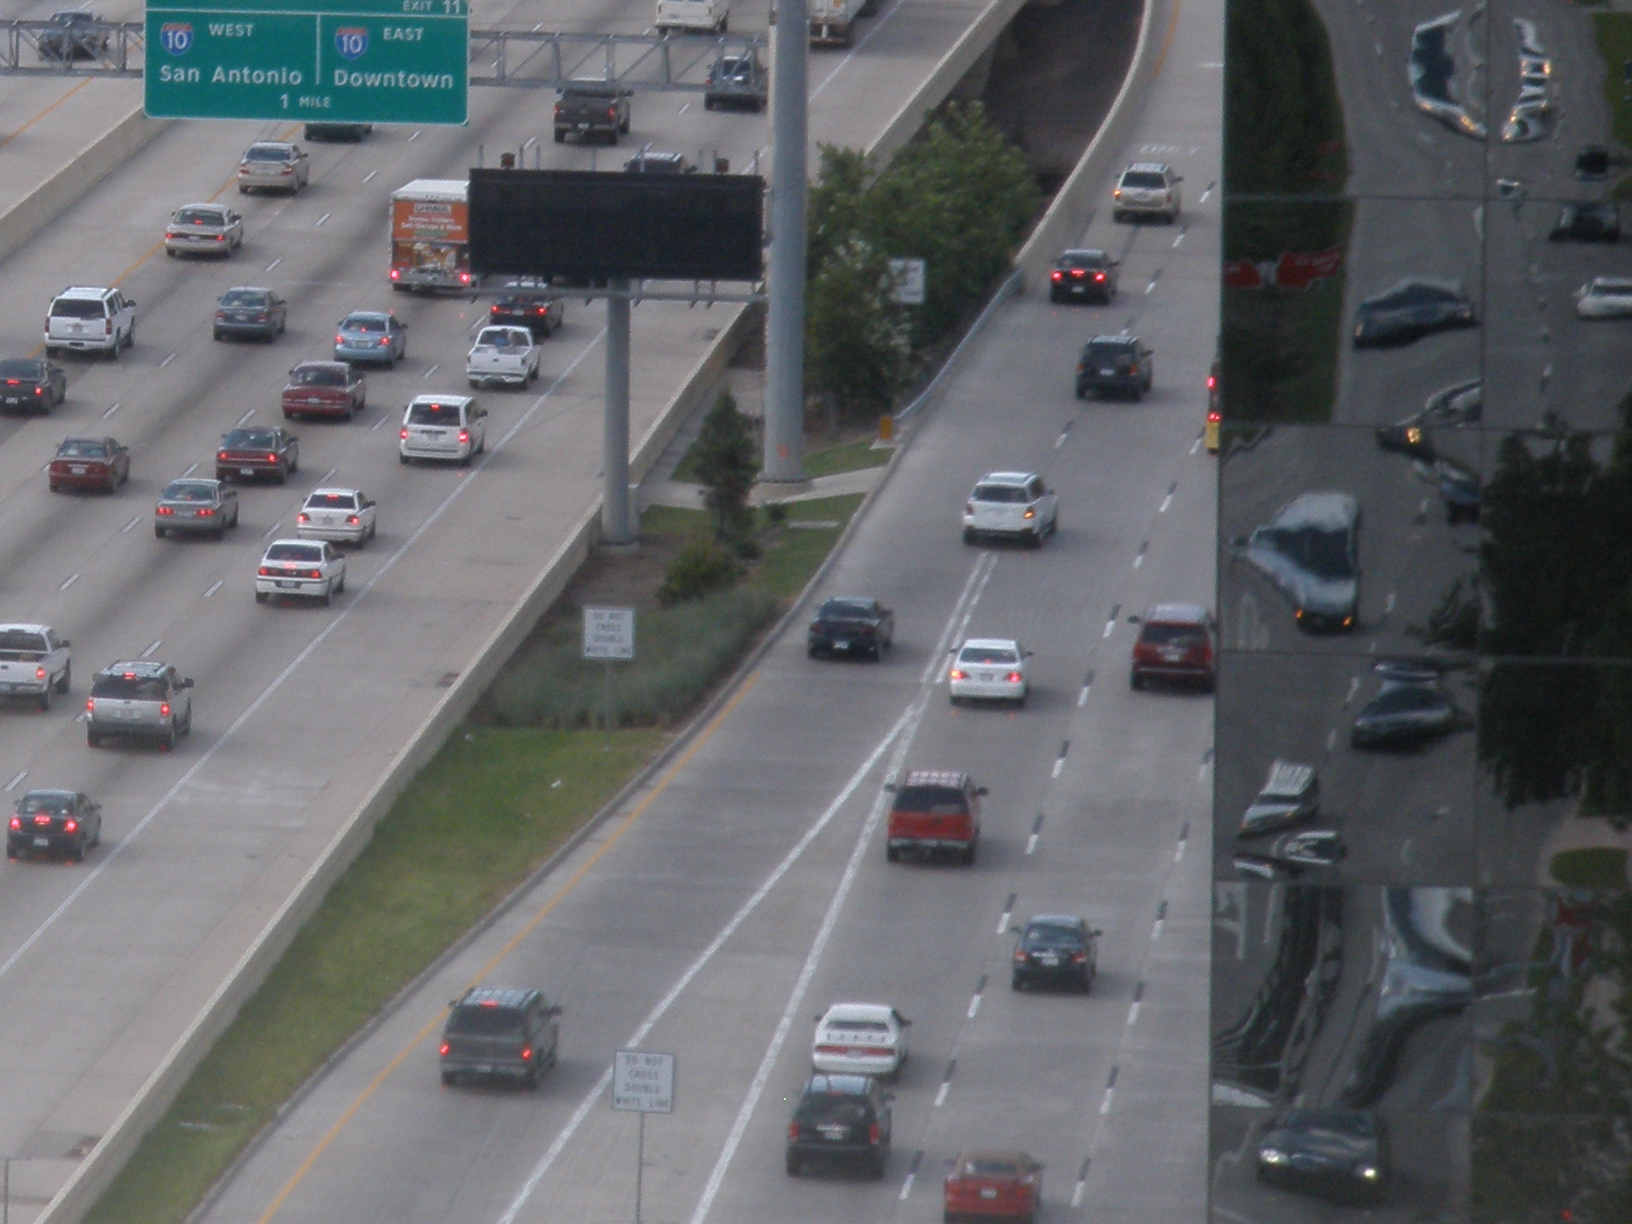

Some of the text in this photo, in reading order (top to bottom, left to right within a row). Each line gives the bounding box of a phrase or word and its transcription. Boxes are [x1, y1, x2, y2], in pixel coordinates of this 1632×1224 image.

[402, 0, 461, 15] EXIT 11
[209, 23, 254, 38] WEST
[382, 27, 425, 41] EAST
[167, 31, 188, 50] 10
[341, 34, 363, 54] 10
[159, 64, 303, 86] San Antonio
[334, 68, 454, 89] Downtown
[280, 93, 332, 110] 1 MILE
[628, 1069, 659, 1081] CROSS
